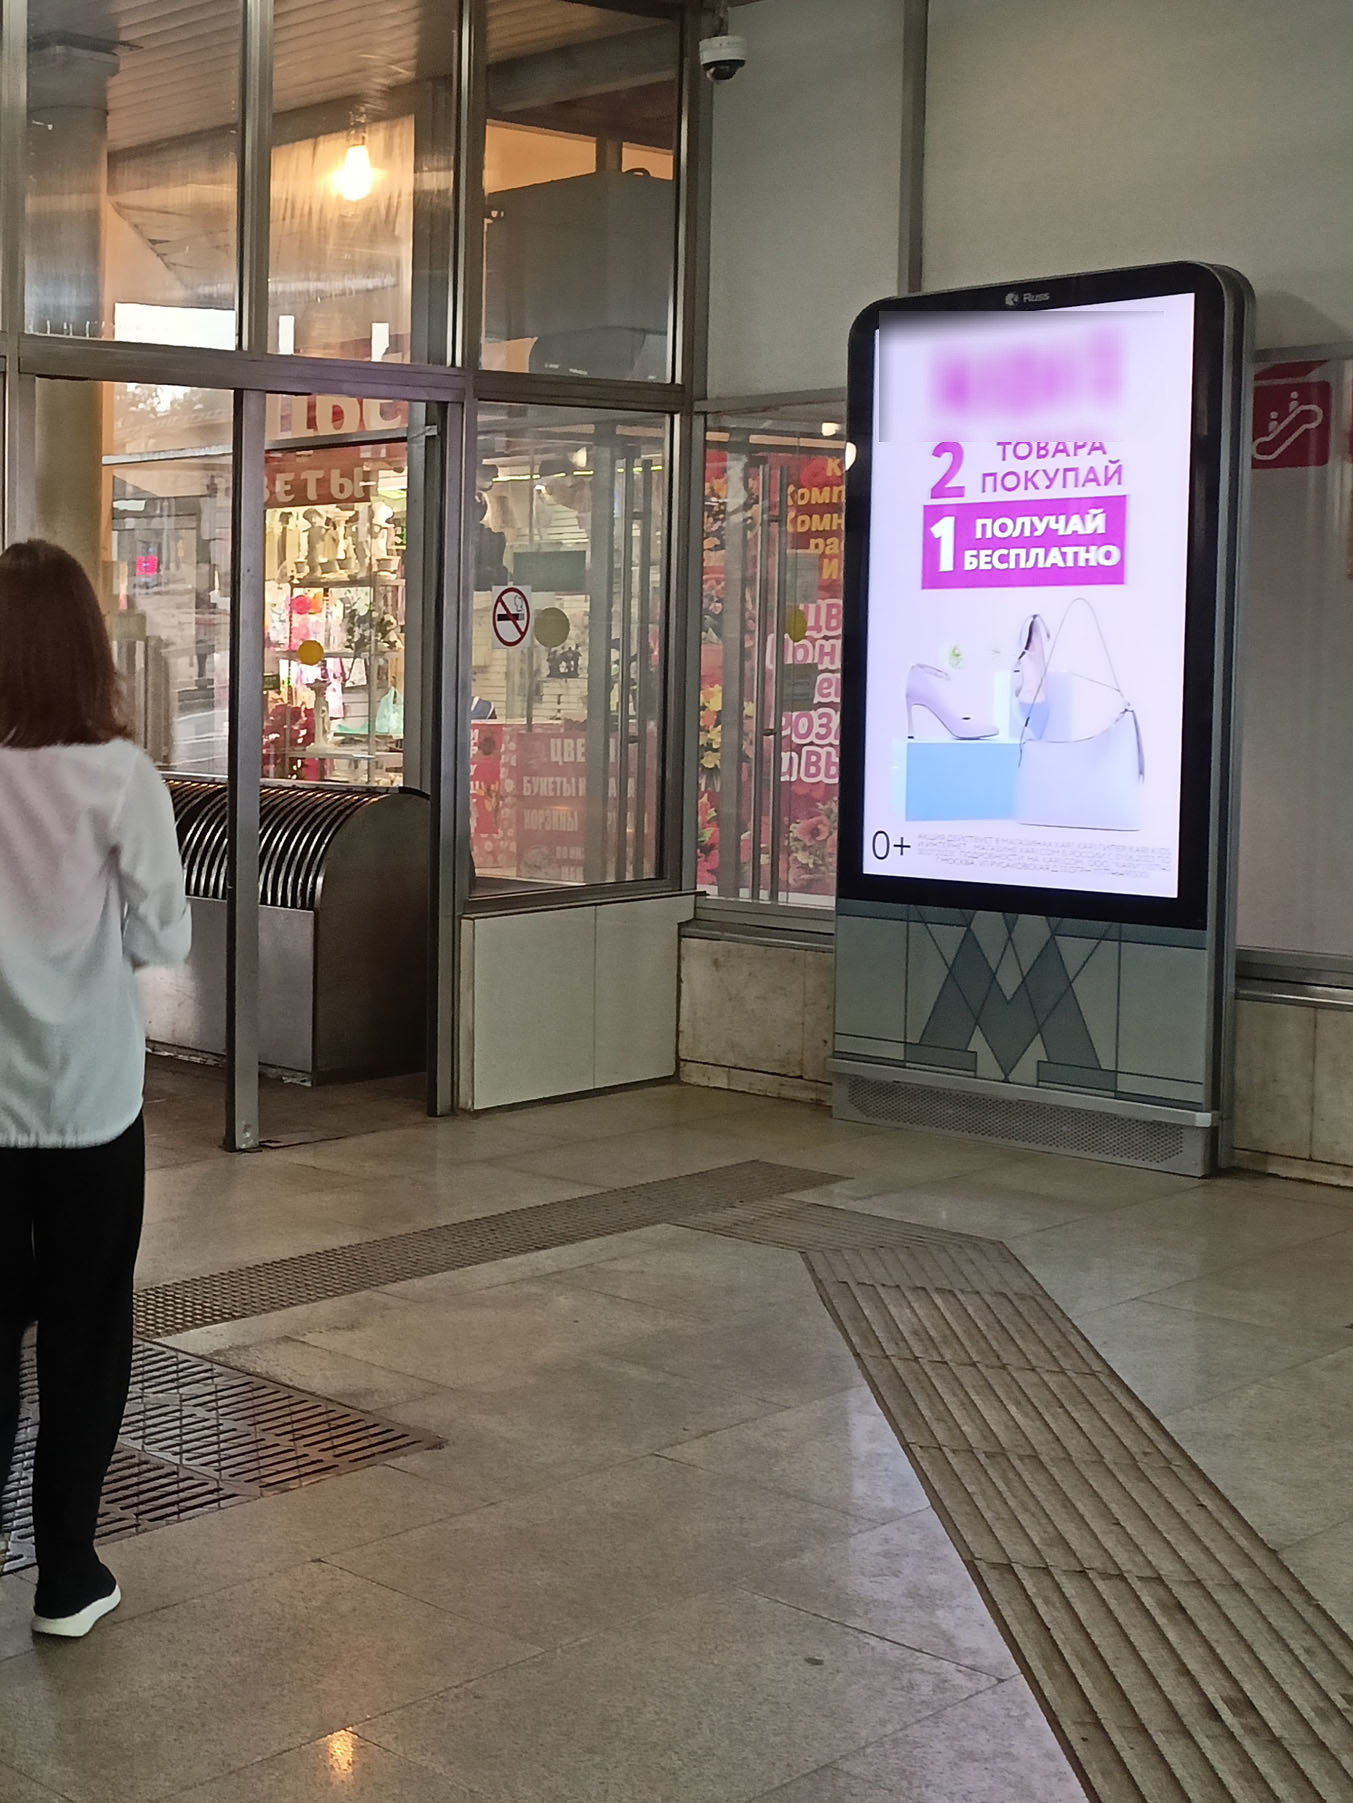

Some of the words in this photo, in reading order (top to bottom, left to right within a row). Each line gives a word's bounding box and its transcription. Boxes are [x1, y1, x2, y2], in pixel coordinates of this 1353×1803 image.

[996, 441, 1107, 462] ТОВАРА
[930, 441, 965, 499] 2
[981, 459, 1123, 493] ПОКУПАЙ
[975, 508, 1107, 540] ПОЛУЧАЙ
[930, 515, 956, 572] 1
[963, 543, 1122, 571] БЕСПЛАТНО
[871, 830, 912, 861] 0+
